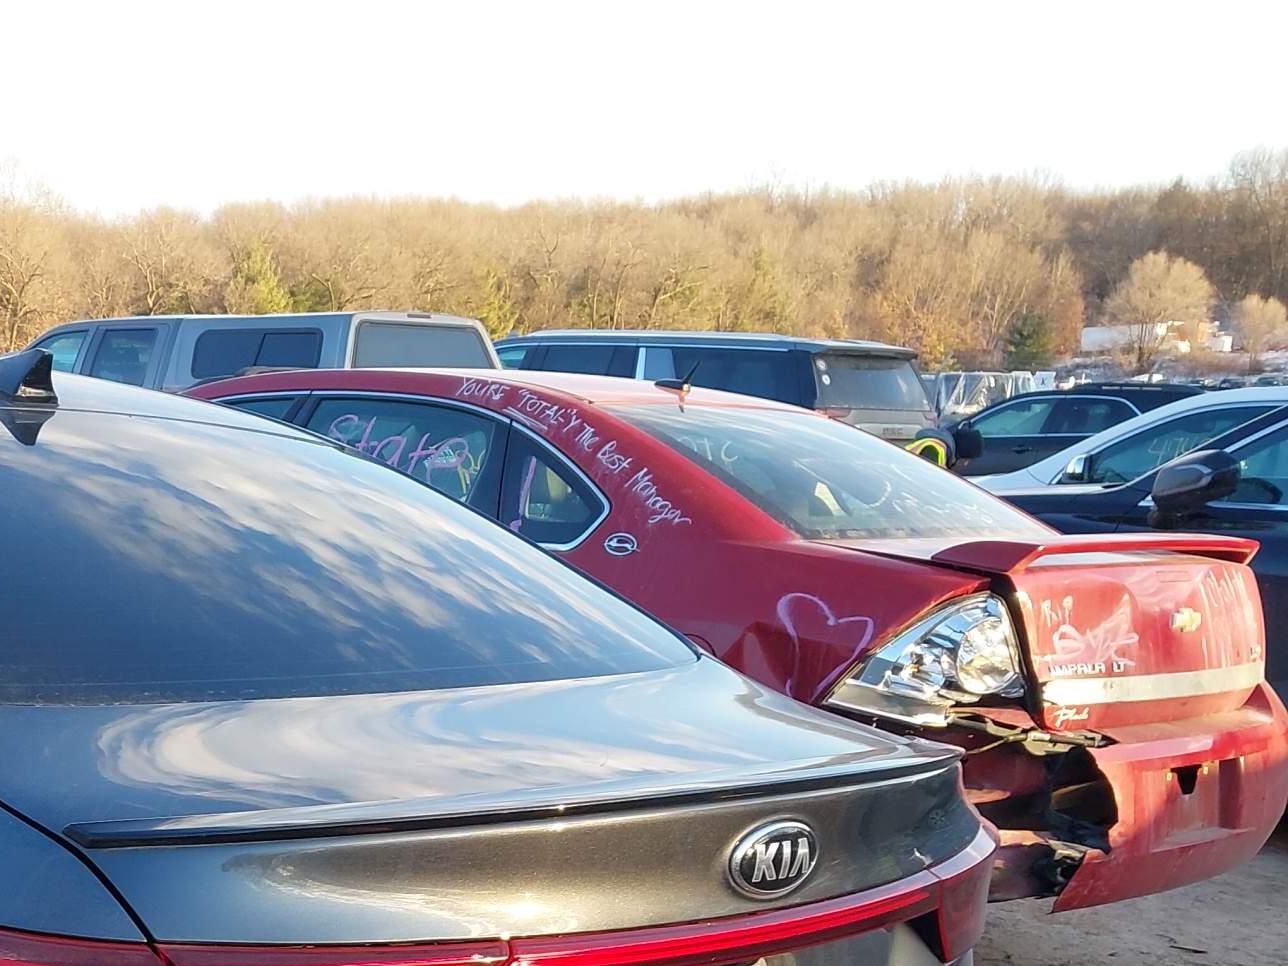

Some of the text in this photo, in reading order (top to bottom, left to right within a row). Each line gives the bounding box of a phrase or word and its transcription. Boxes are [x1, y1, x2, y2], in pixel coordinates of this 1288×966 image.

[1048, 661, 1126, 675] IMPALA LT
[752, 837, 811, 883] KIA
